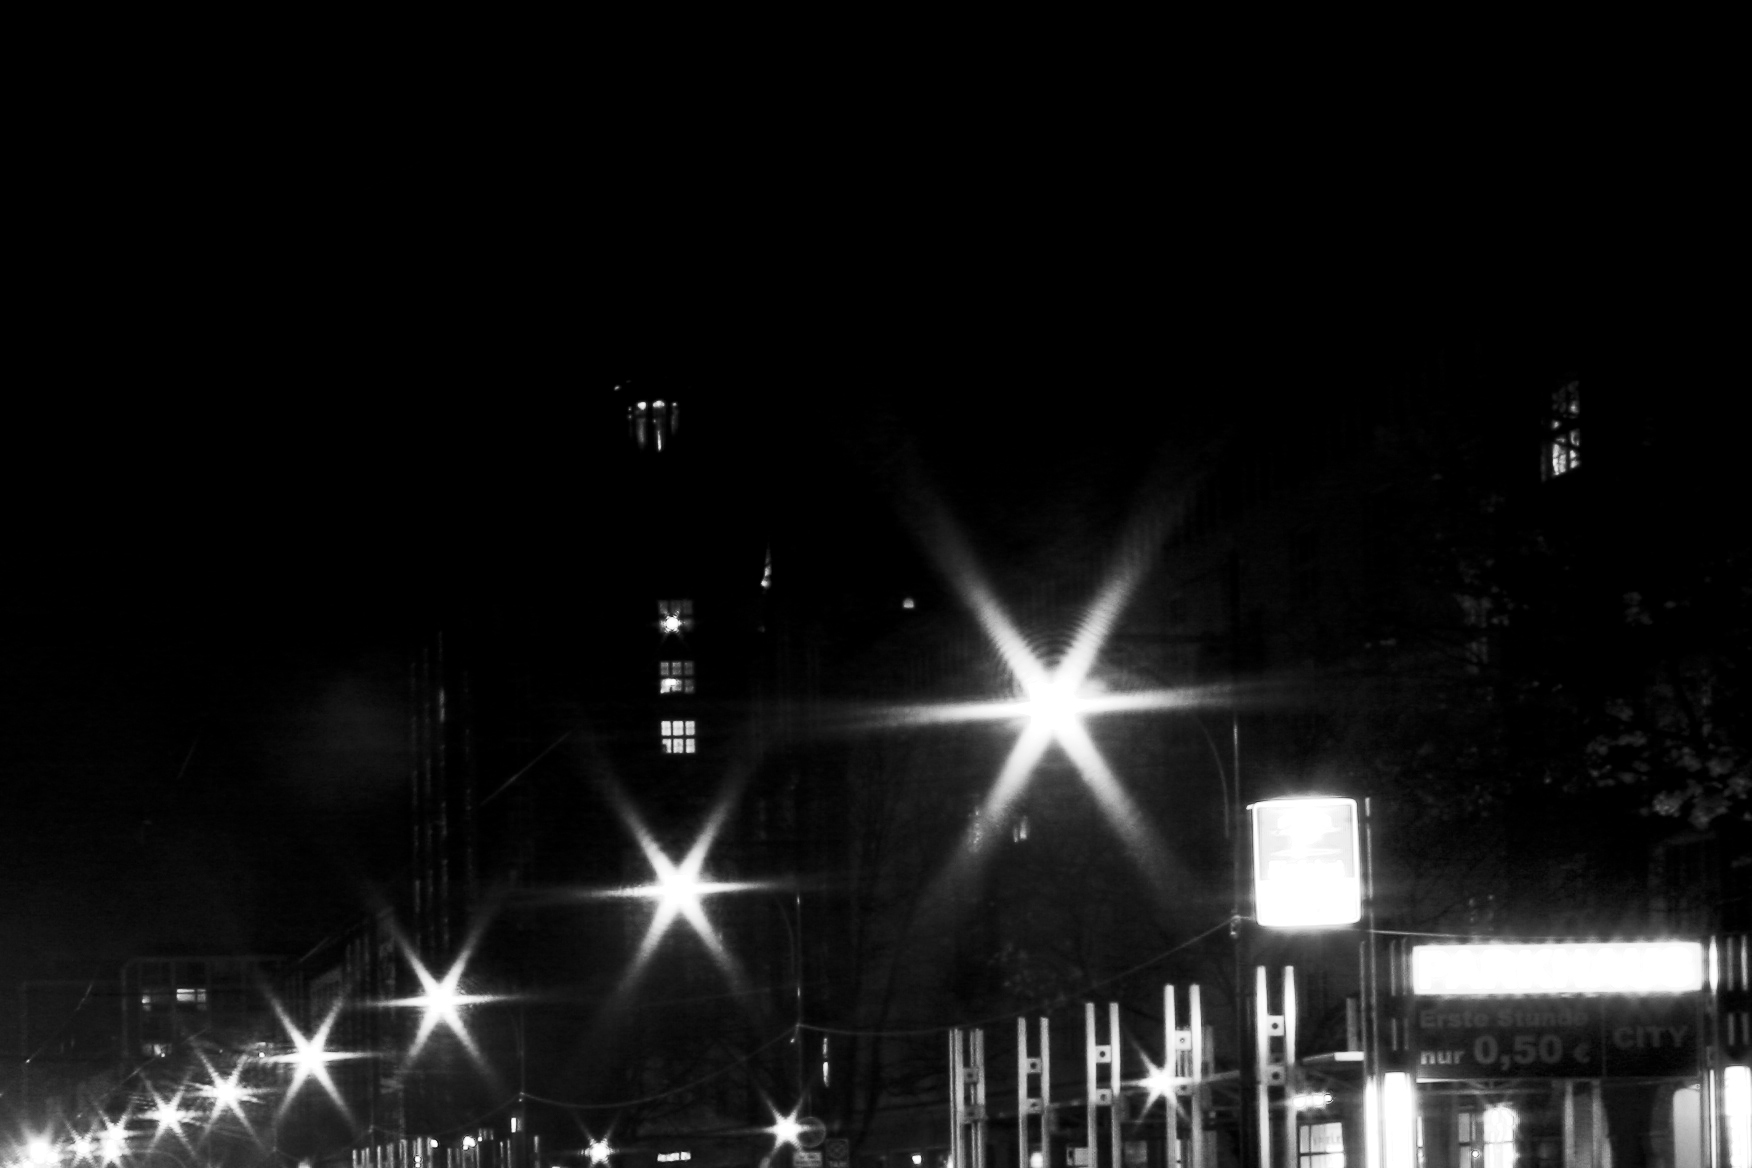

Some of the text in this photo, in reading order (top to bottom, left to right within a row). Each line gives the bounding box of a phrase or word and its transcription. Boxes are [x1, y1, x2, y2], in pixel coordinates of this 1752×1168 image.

[1420, 1007, 1589, 1028] Erste Stunde
[1613, 1025, 1688, 1048] CITY
[1420, 1034, 1591, 1071] nur 0,50 €
